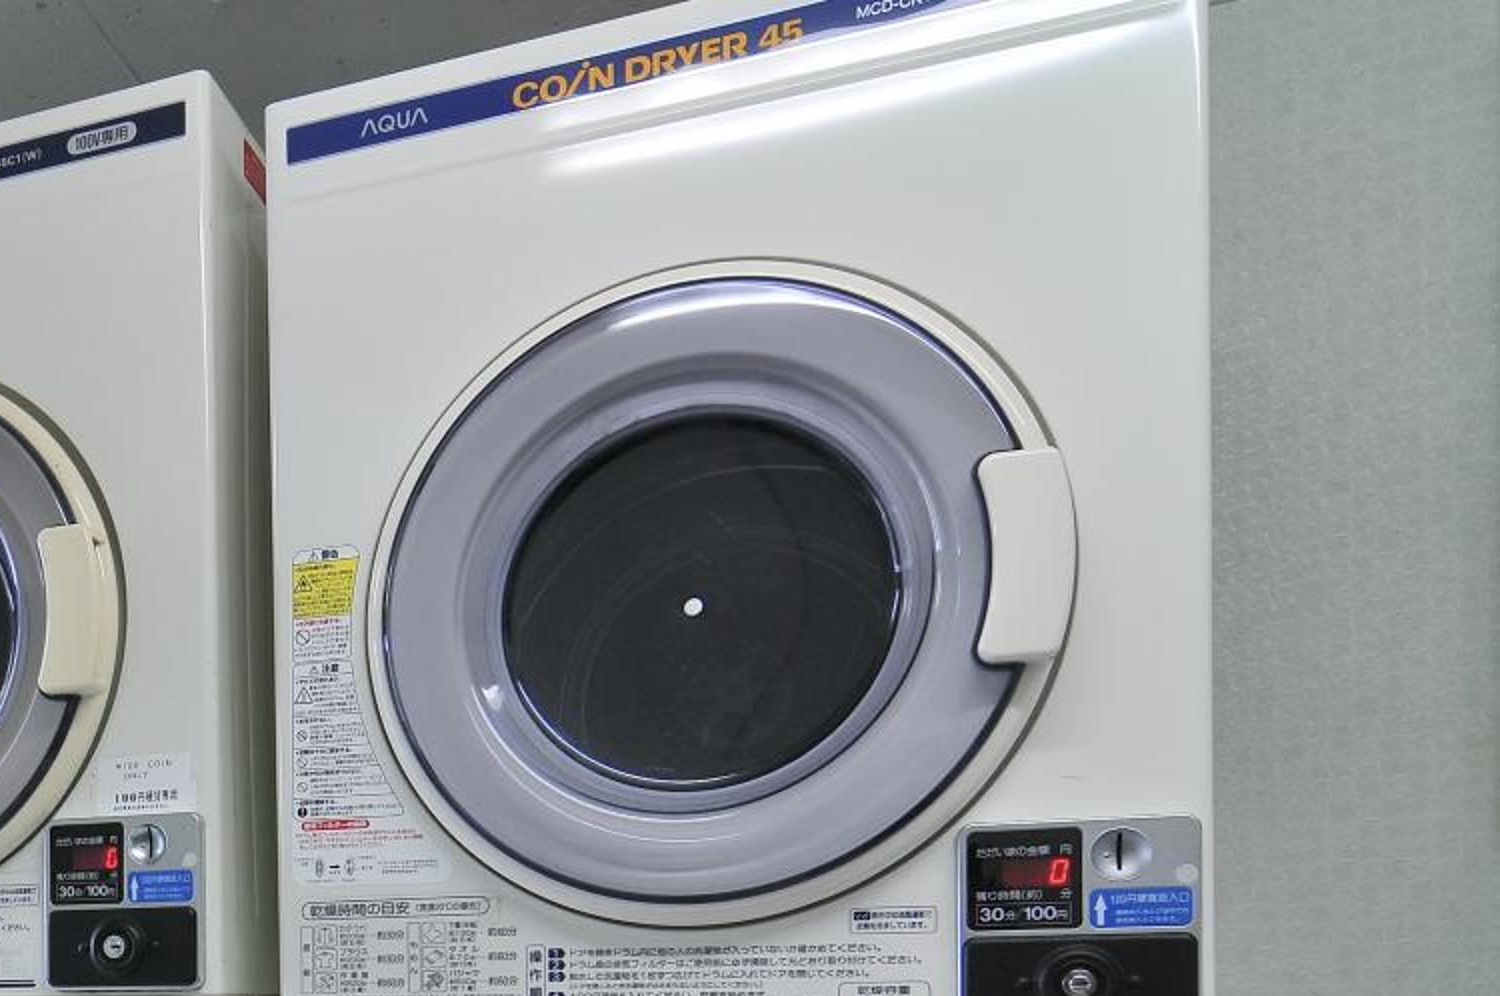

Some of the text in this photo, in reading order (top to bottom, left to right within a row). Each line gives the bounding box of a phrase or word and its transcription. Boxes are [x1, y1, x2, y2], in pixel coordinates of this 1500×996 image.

[360, 107, 429, 138] AQUA
[624, 34, 749, 84] DRYER
[758, 18, 804, 49] 45
[1049, 857, 1071, 885] 0
